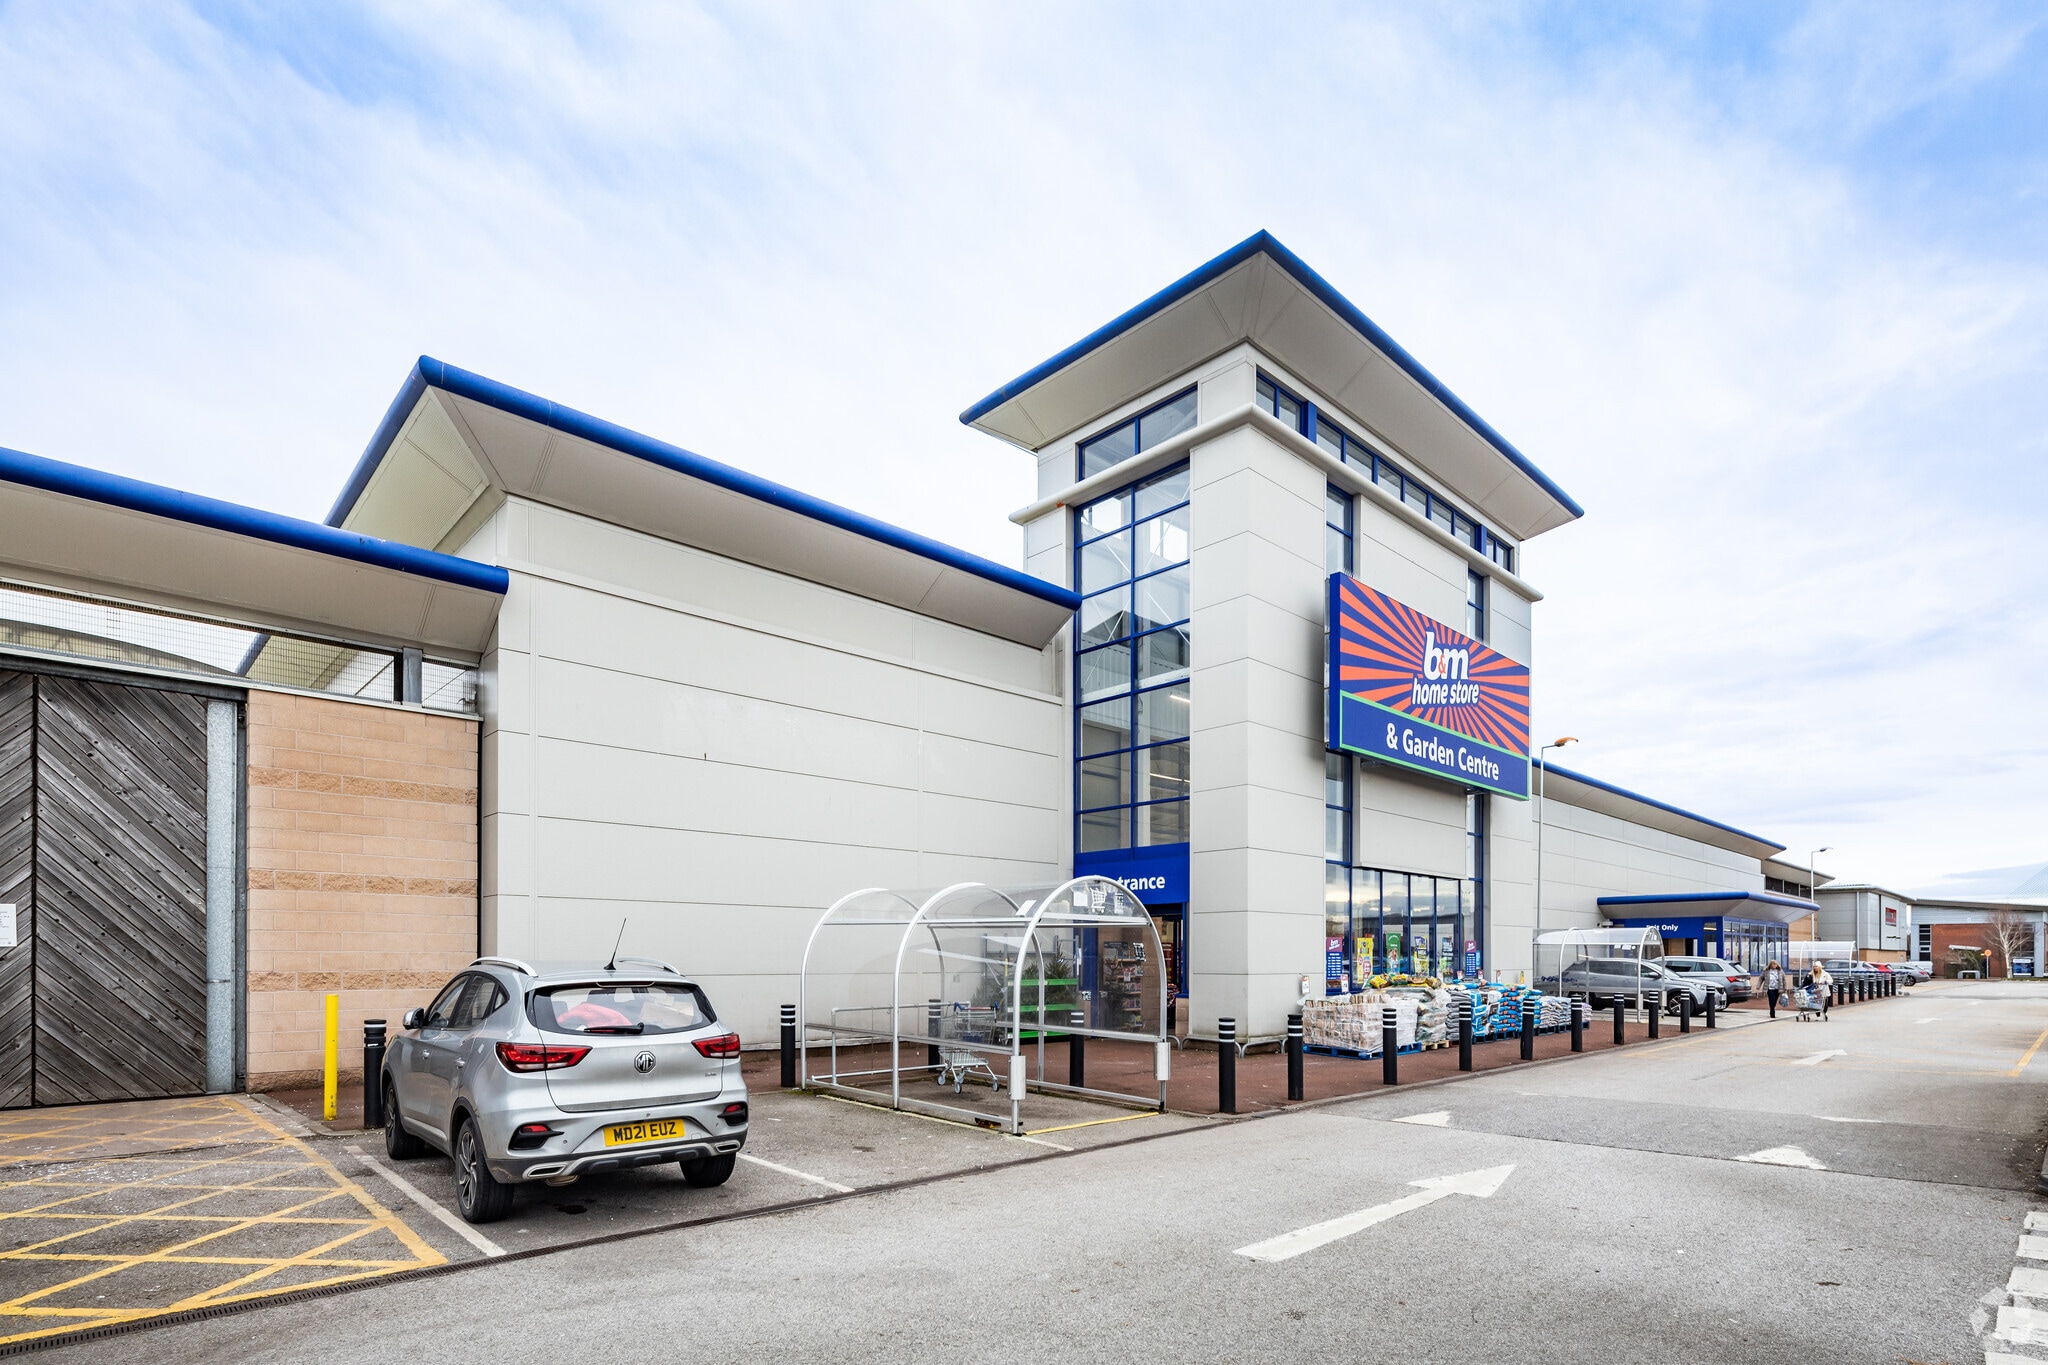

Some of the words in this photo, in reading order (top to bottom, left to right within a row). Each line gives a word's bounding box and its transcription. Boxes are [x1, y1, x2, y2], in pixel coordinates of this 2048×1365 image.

[1412, 677, 1449, 705] home
[1449, 680, 1480, 704] store
[1386, 722, 1399, 750] &
[1402, 728, 1455, 767] Garden
[1458, 747, 1500, 781] Centre
[1117, 876, 1166, 891] trance
[1661, 924, 1679, 932] Only
[637, 1053, 655, 1072] MG
[613, 1125, 647, 1142] MD21
[650, 1122, 677, 1137] EUZ
